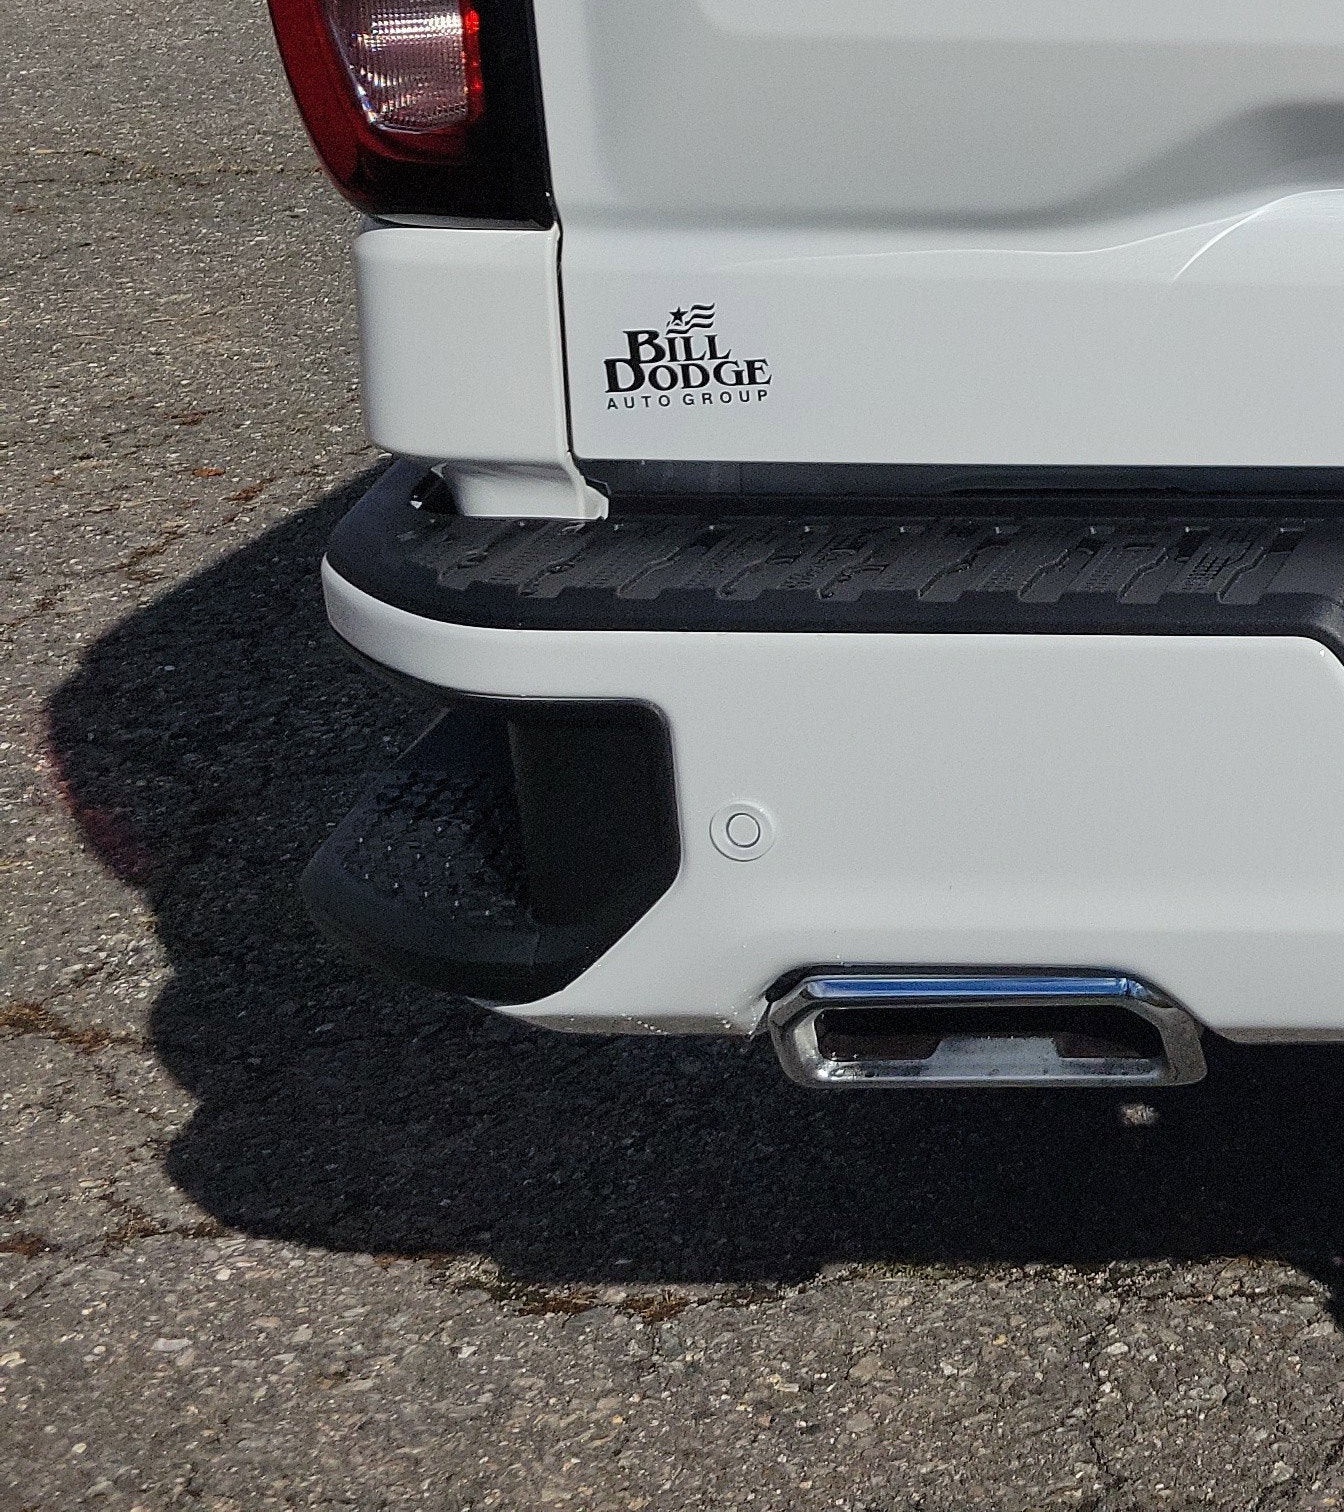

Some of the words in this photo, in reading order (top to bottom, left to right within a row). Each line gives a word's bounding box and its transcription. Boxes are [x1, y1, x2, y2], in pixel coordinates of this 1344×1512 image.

[623, 330, 731, 364] BILL
[604, 358, 772, 393] DODGE
[607, 396, 671, 410] AUTO
[683, 389, 768, 406] GROUP
